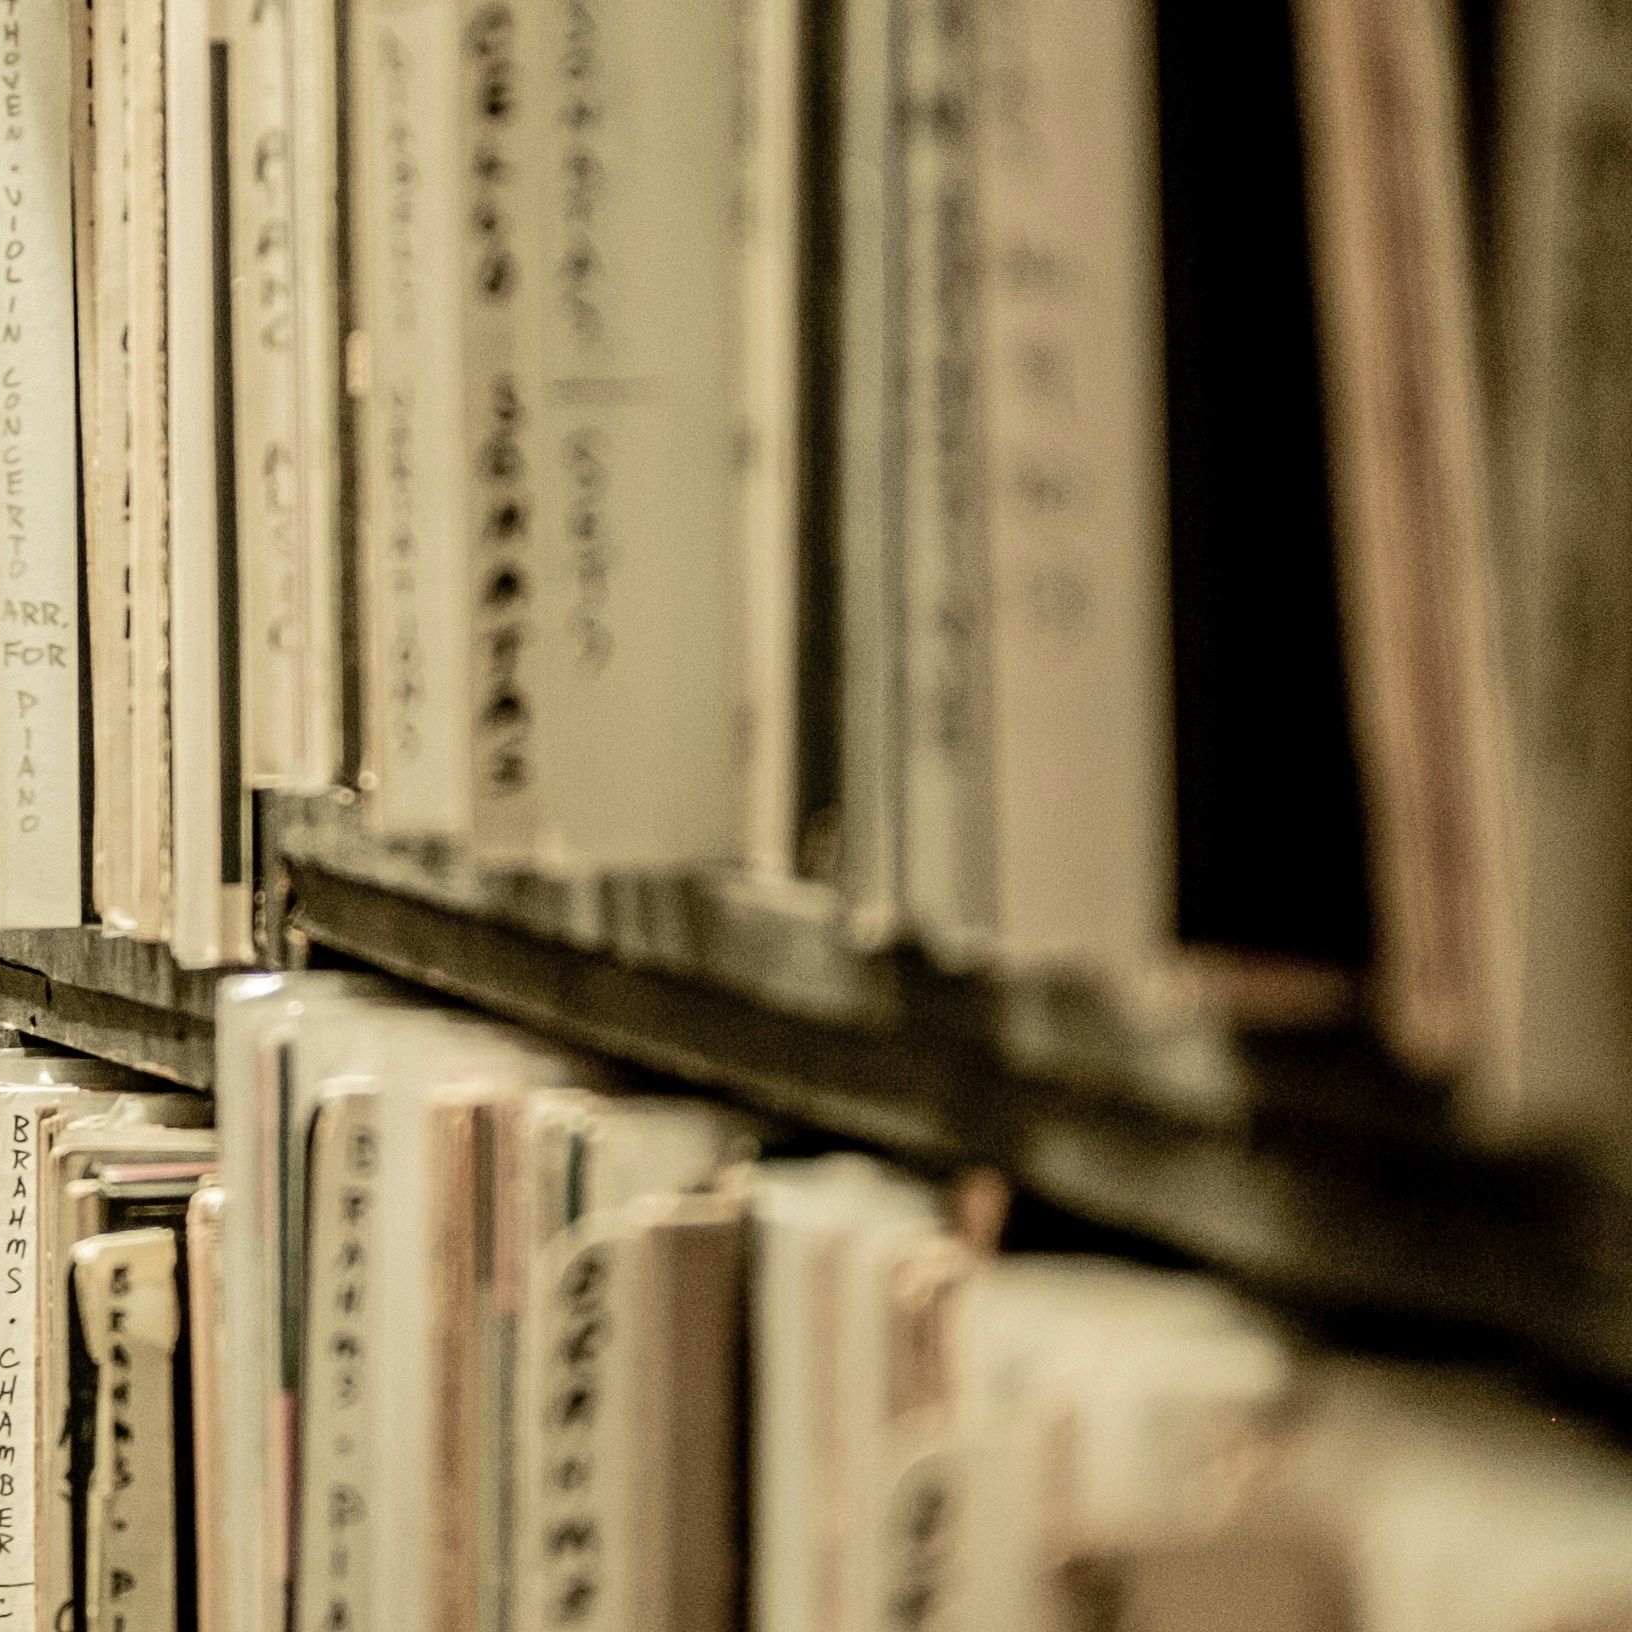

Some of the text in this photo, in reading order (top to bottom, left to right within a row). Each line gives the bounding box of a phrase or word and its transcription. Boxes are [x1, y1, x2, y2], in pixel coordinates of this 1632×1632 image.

[2, 185, 26, 348] VIOLIN
[0, 366, 27, 582] CONCERTO
[1, 639, 68, 669] FOR
[15, 688, 42, 835] PIANO
[5, 1114, 32, 1295] BRAHMS
